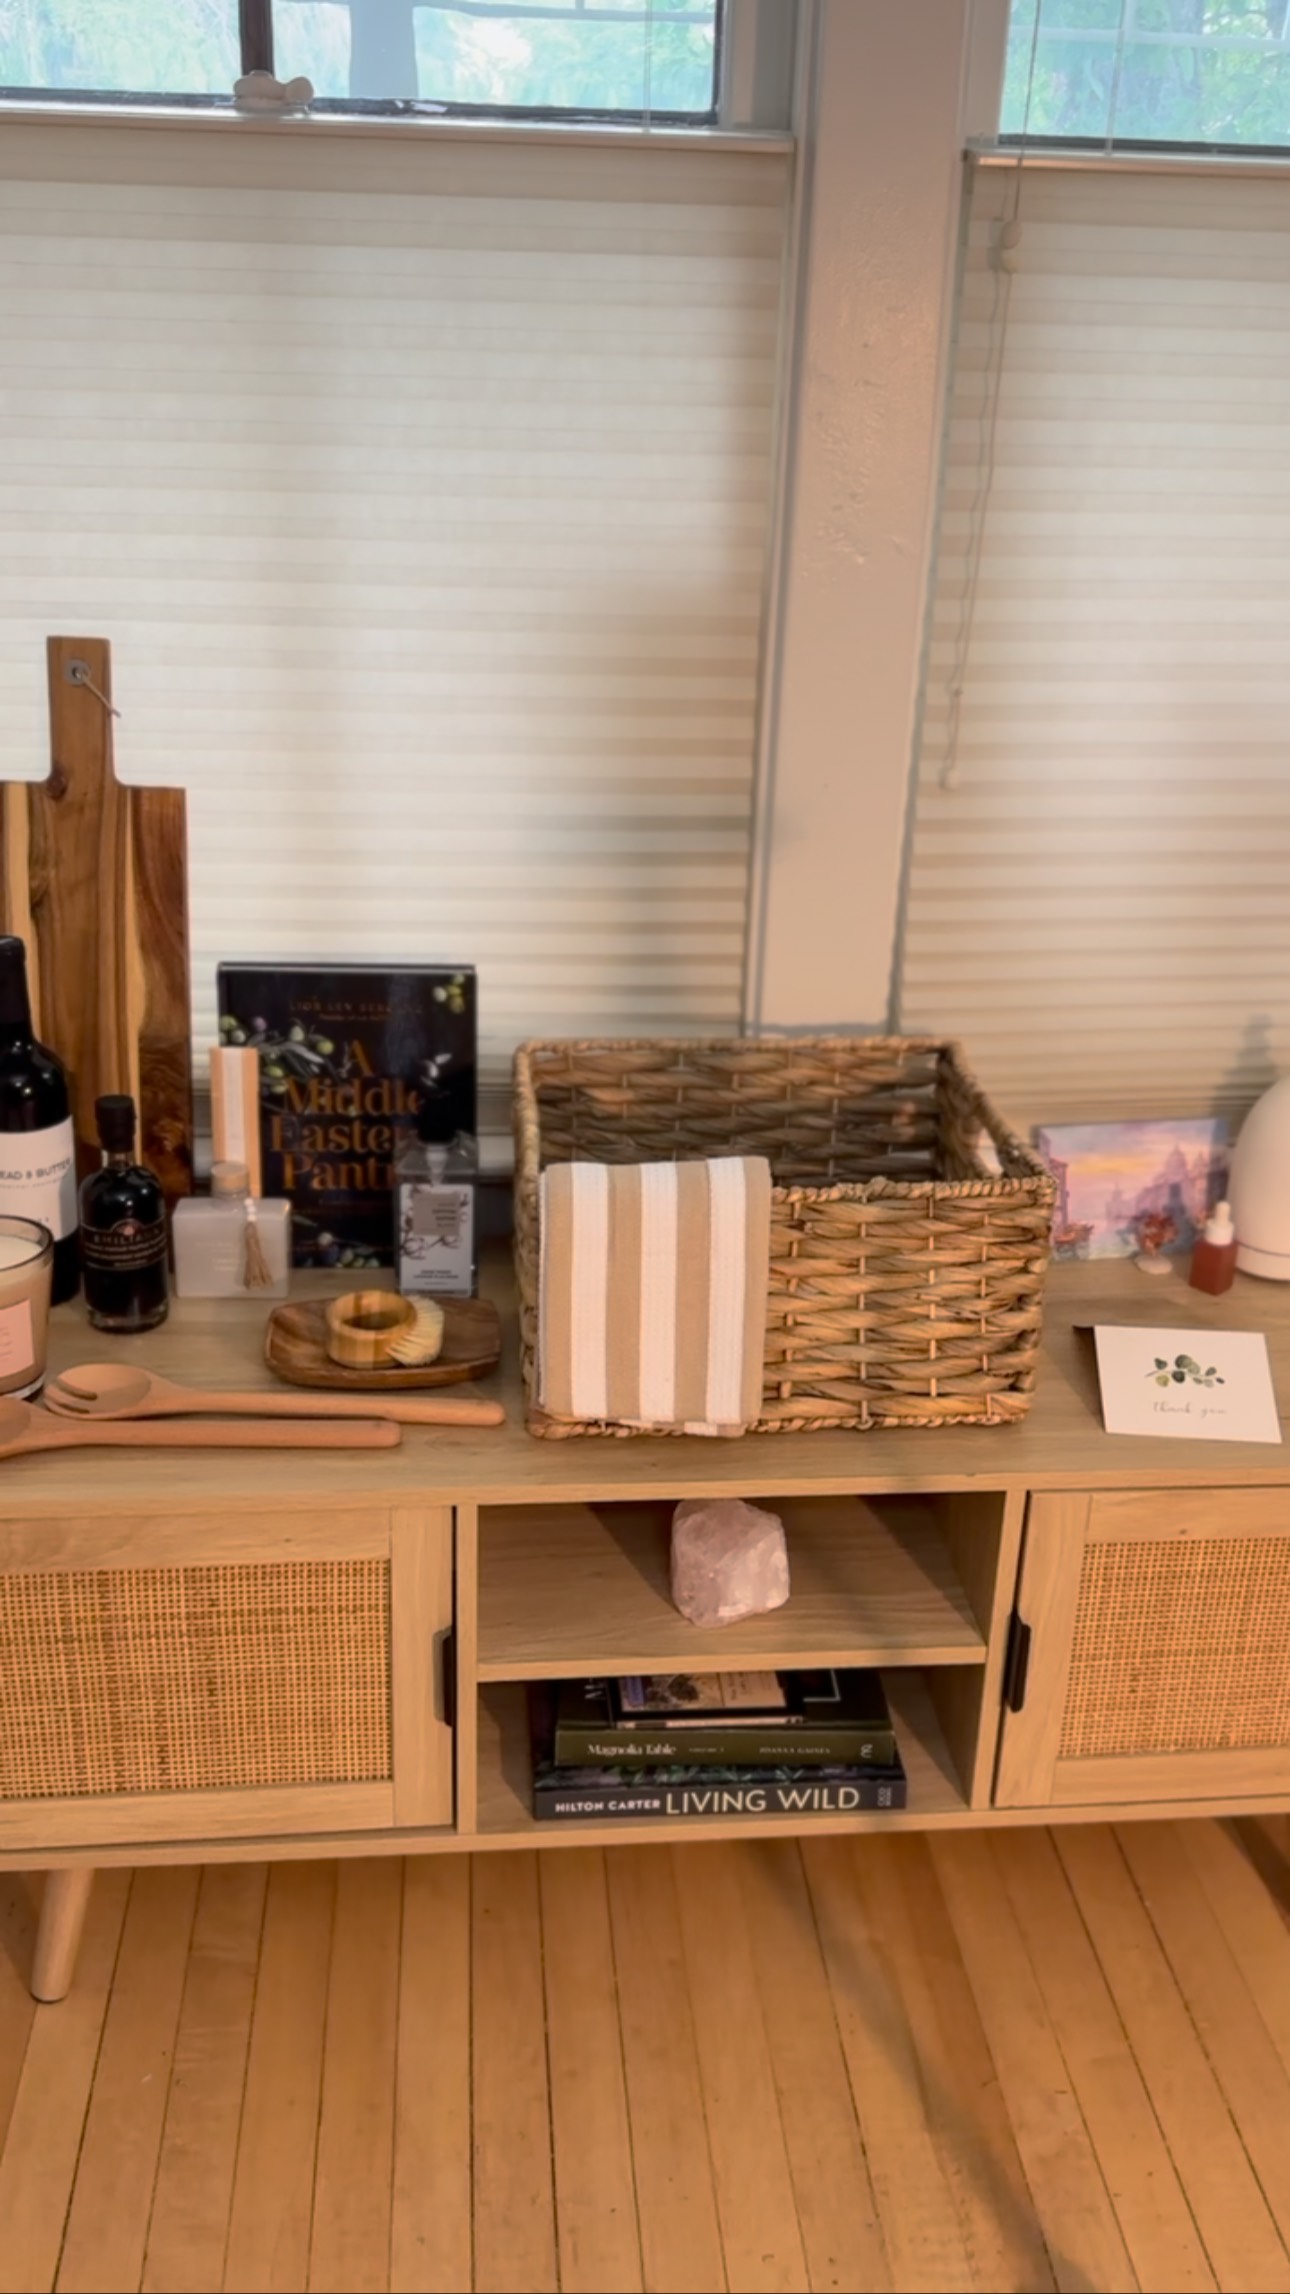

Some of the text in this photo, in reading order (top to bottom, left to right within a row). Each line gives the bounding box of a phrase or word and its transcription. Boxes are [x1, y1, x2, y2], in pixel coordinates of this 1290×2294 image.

[347, 1039, 374, 1078] A
[586, 1743, 643, 1758] Magnolia
[645, 1743, 677, 1756] Table
[555, 1787, 860, 1815] HILTON CARTER LIVING WILD
